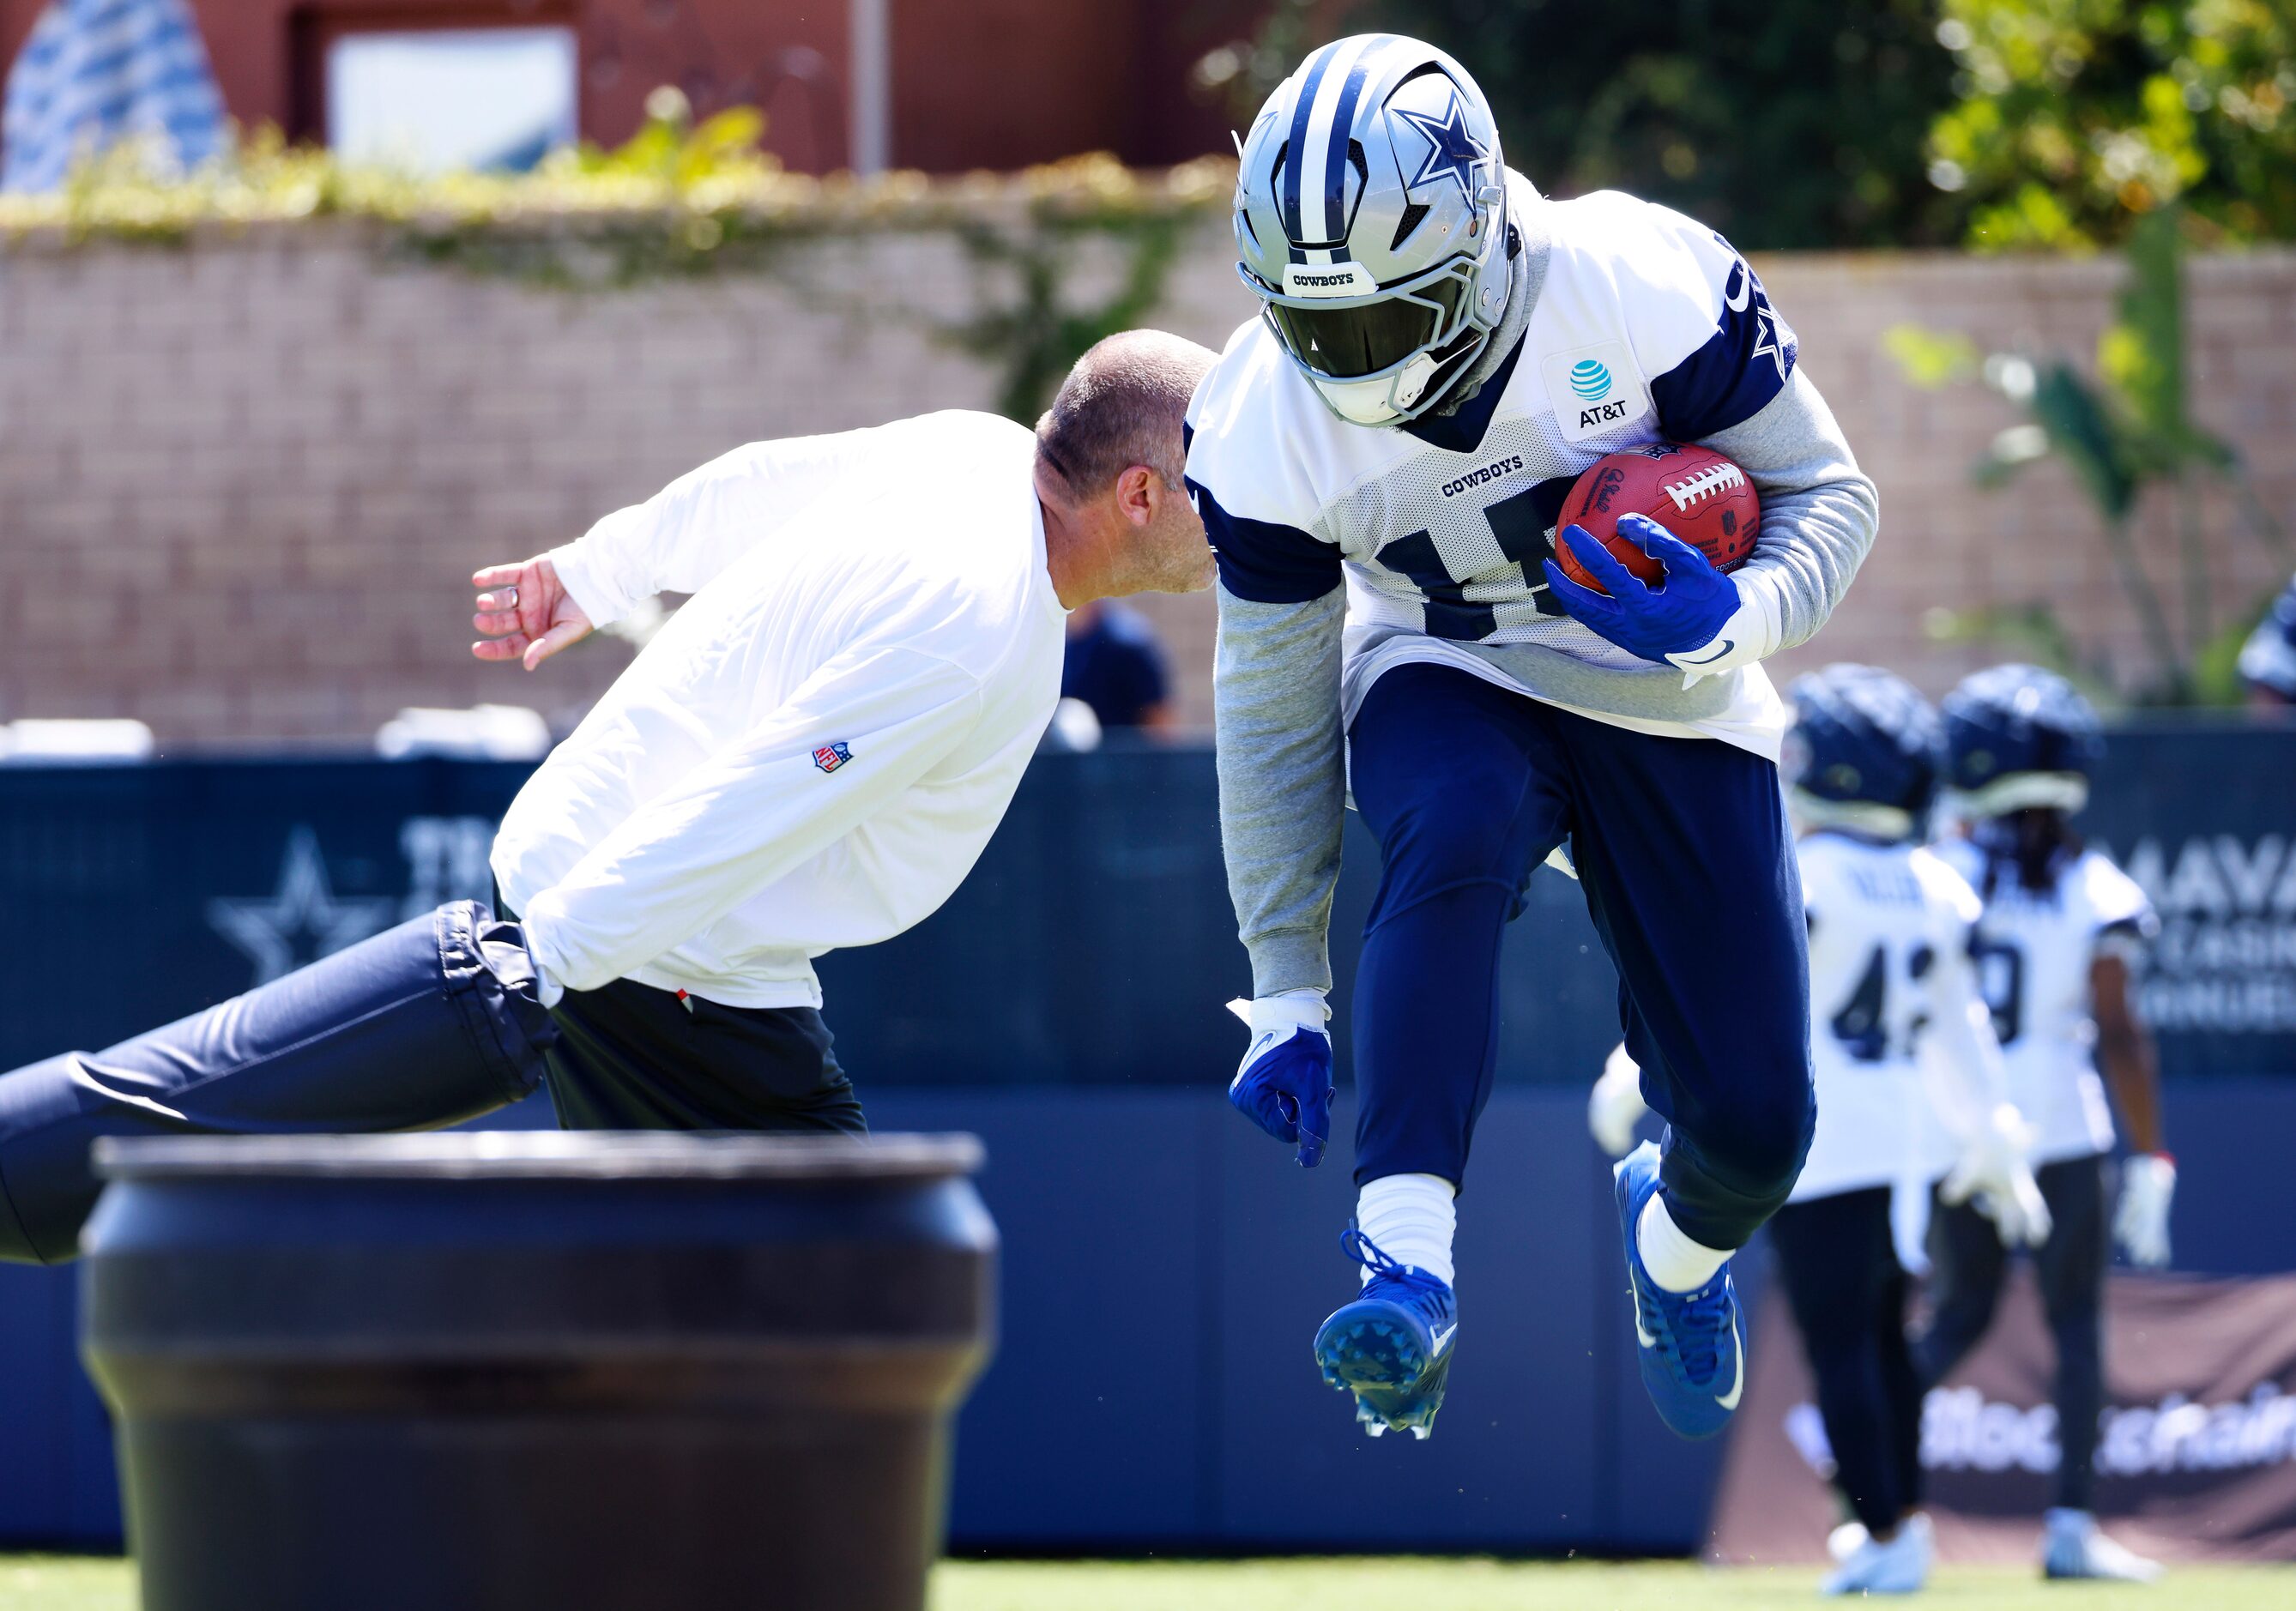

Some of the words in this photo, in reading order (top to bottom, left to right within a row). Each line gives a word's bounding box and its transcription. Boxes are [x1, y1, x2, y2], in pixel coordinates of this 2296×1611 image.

[1293, 273, 1354, 287] COWBOYS
[1580, 400, 1626, 428] AT&T
[1442, 455, 1523, 498] COWBOYS
[815, 746, 839, 771] NFL
